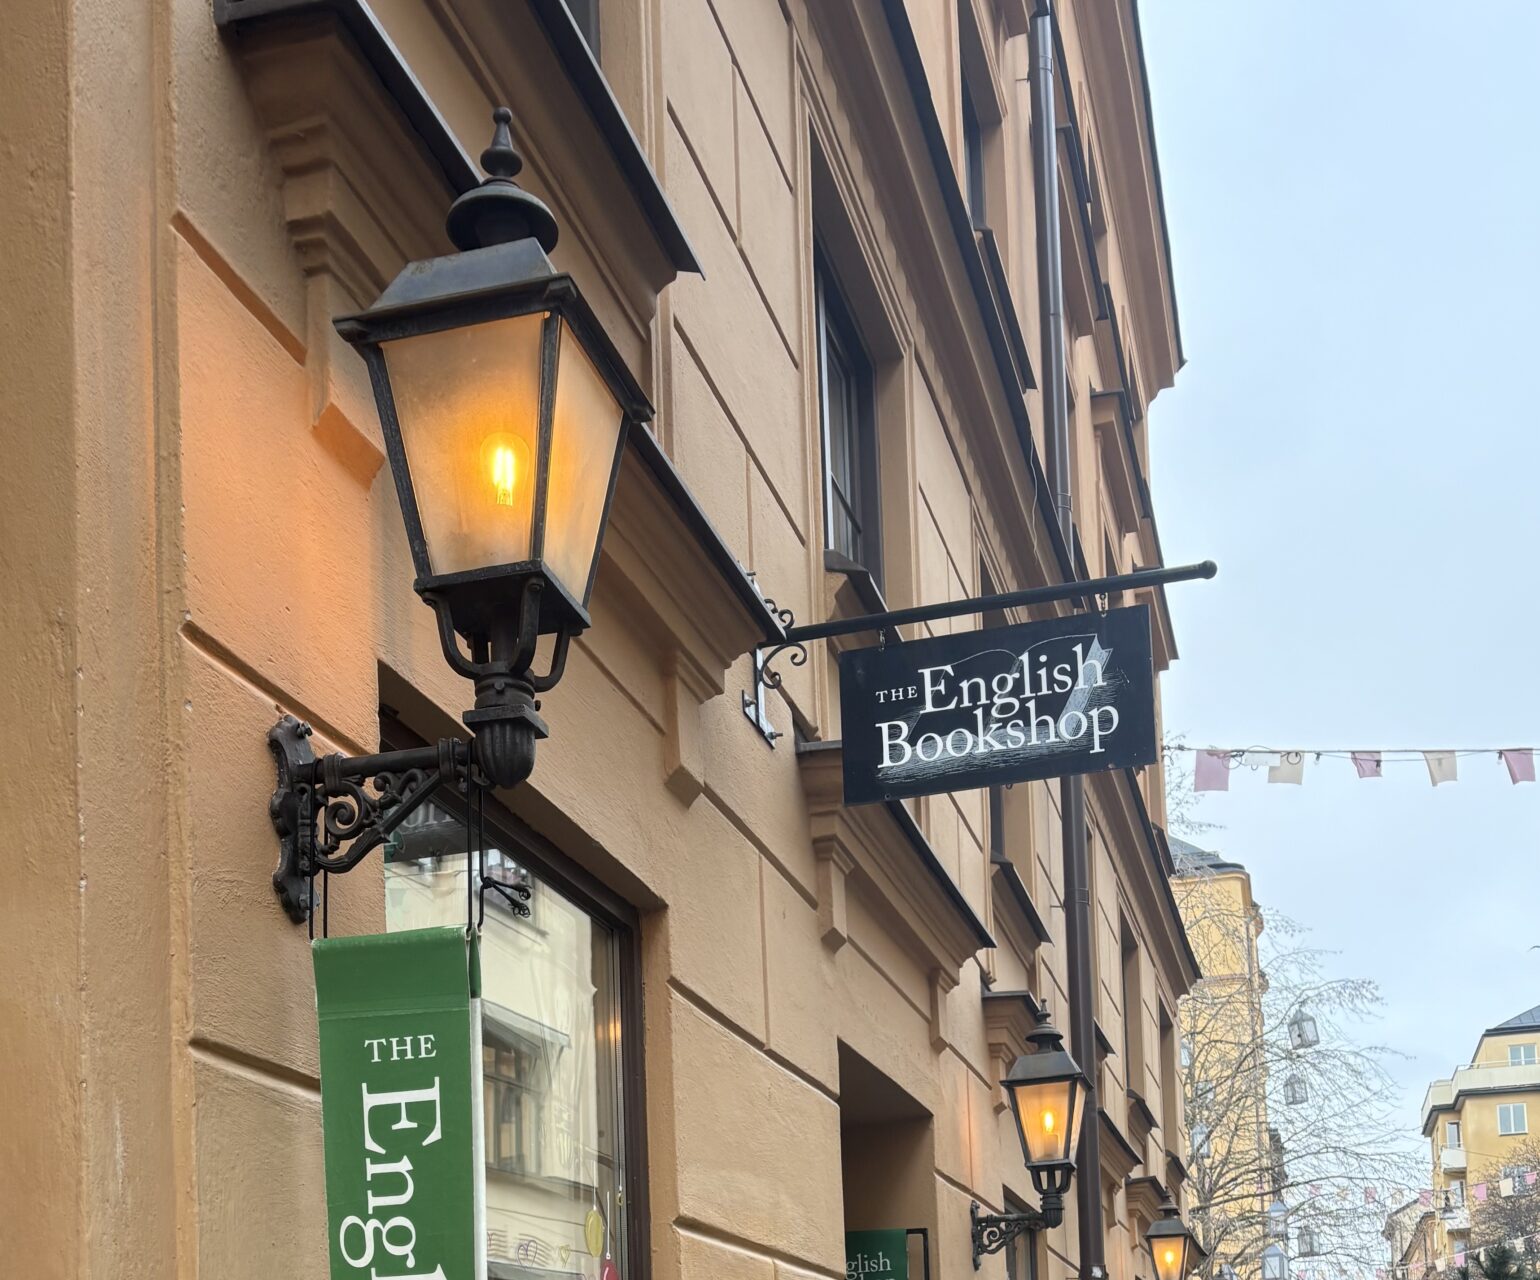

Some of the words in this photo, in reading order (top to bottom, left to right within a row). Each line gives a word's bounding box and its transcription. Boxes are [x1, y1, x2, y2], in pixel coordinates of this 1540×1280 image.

[875, 685, 919, 704] THE
[917, 643, 1107, 718] English
[875, 698, 1119, 769] Bookshop
[364, 1034, 437, 1064] THE
[846, 1251, 893, 1280] glish
